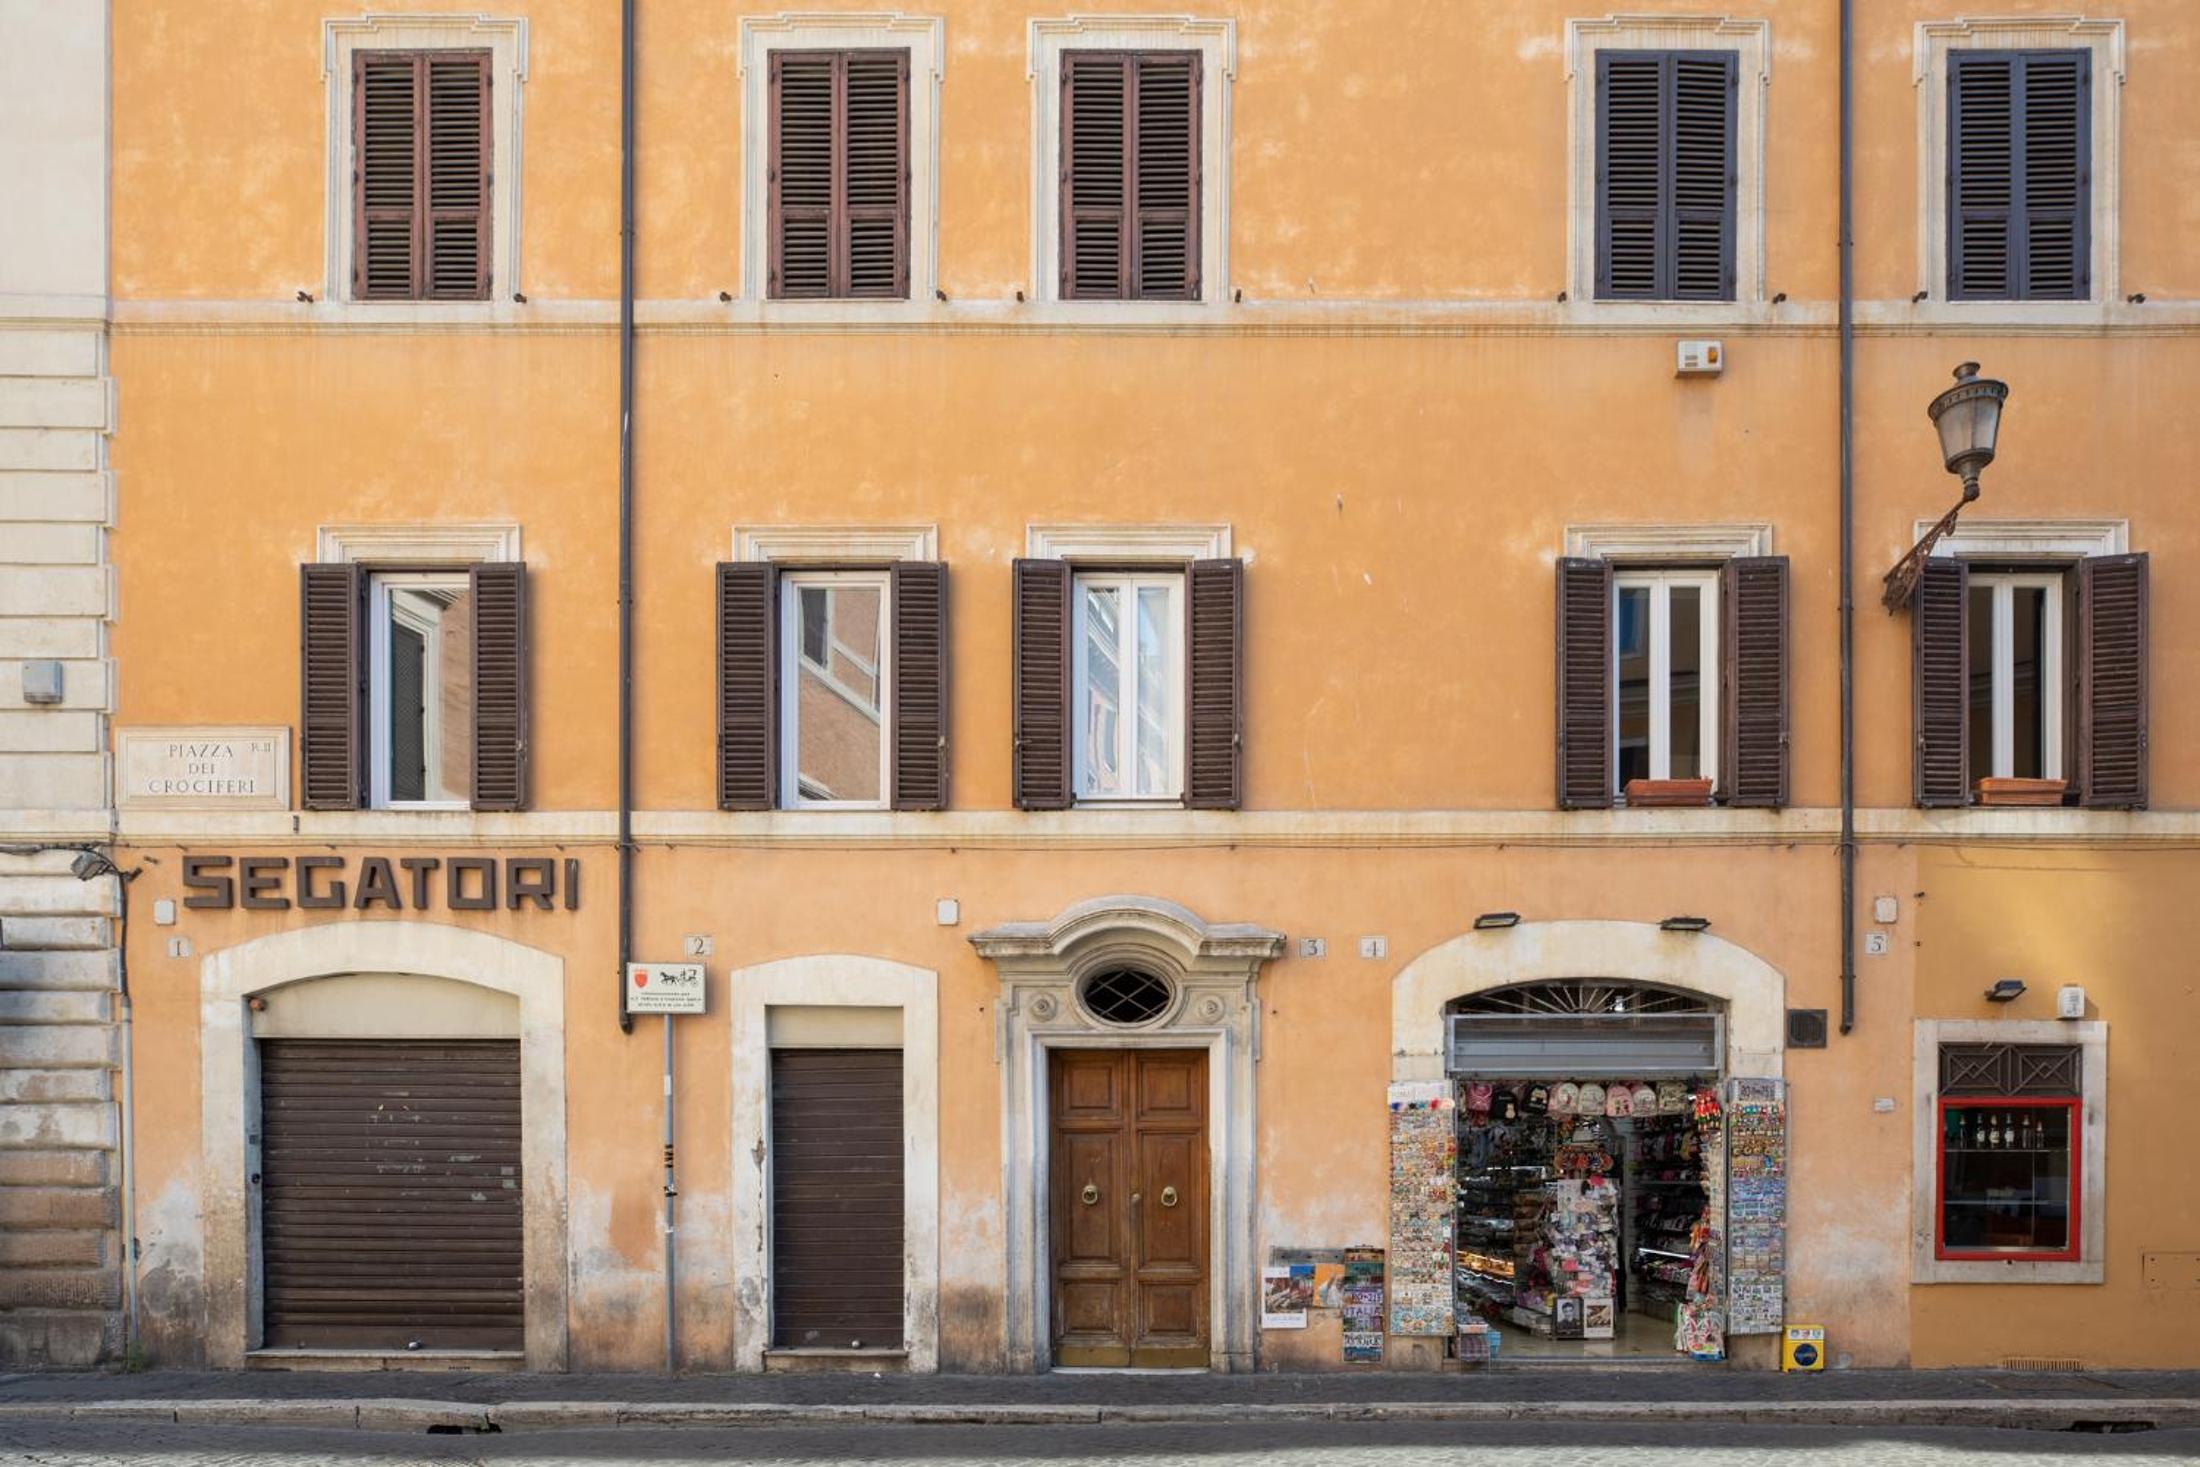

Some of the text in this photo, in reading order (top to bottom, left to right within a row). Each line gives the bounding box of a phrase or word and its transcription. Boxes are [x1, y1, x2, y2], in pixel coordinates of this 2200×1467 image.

[169, 744, 234, 758] PIAZZA
[188, 763, 216, 775] DEI
[148, 779, 255, 794] CROCIFERI
[182, 855, 580, 911] SEGATORI
[693, 937, 705, 955] 2
[1307, 939, 1318, 956] 3
